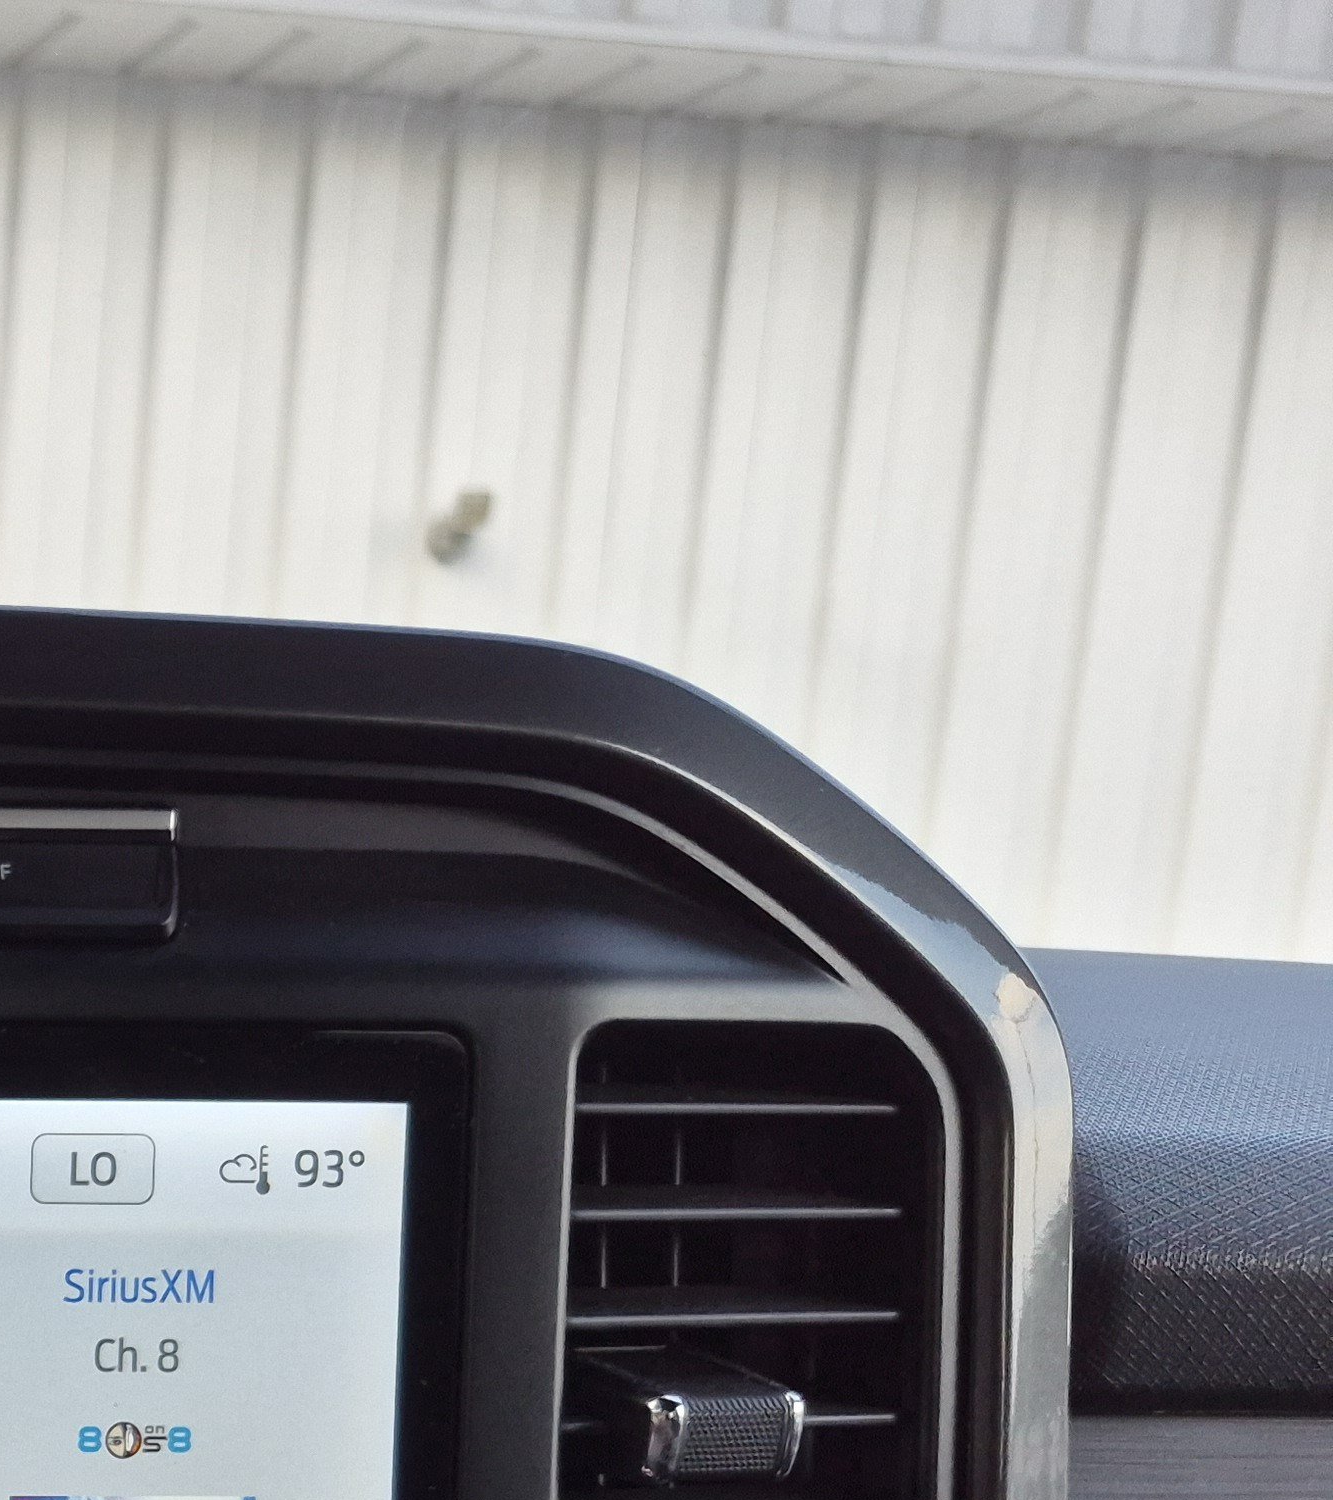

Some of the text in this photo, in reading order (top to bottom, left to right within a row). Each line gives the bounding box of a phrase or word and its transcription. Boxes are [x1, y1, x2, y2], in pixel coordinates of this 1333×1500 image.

[69, 1151, 117, 1187] LO
[293, 1148, 366, 1190] 93°
[63, 1268, 215, 1304] SiriusXM
[94, 1339, 180, 1374] Ch. 8
